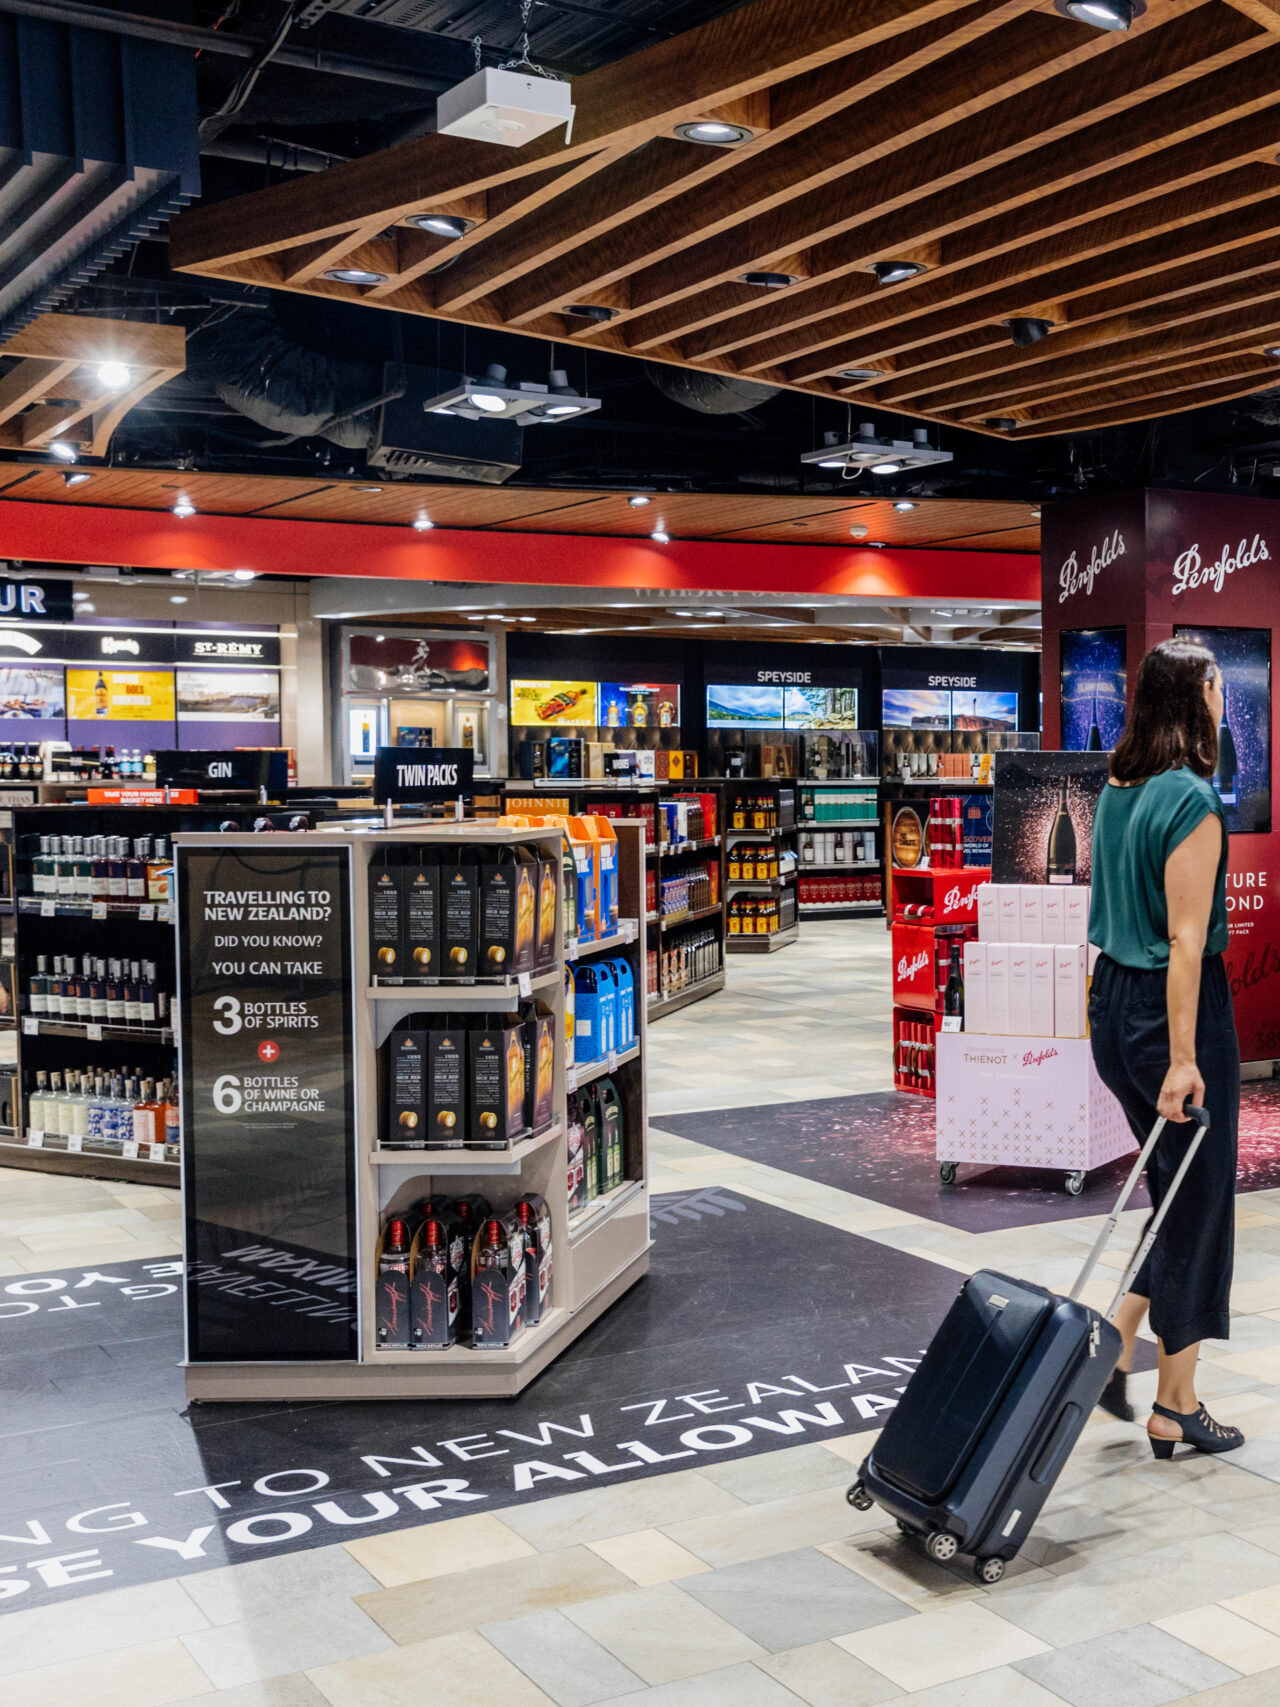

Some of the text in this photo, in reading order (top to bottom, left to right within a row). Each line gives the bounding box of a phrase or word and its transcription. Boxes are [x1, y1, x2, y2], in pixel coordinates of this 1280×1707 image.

[1059, 529, 1126, 603] Penfolds
[1172, 534, 1269, 595] Penfolds
[757, 671, 812, 684] SPEYSIDE
[928, 676, 977, 688] SPEYSIDE
[208, 762, 232, 778] GIN
[397, 764, 458, 786] TWIN PACKS
[506, 798, 569, 812] JOHNNIE
[204, 891, 330, 905] TRAVELLING TO
[204, 907, 332, 921] NEW ZEALAND?
[214, 935, 322, 947] DID YOU KNOW?
[212, 962, 322, 975] YOU CAN TAKE
[897, 950, 929, 982] Penfolds
[213, 996, 307, 1035] 3 BOTTLES
[244, 1016, 319, 1028] OF SPIRITS
[1022, 1048, 1058, 1066] Penfolds
[213, 1074, 298, 1114] 6 BOTTLES
[244, 1089, 319, 1099] OF WINE OR
[244, 1101, 326, 1112] CHAMPAGNE
[174, 1350, 928, 1510] TO NEW ZEALAN
[134, 1386, 908, 1560] YOUR ALLOWA
